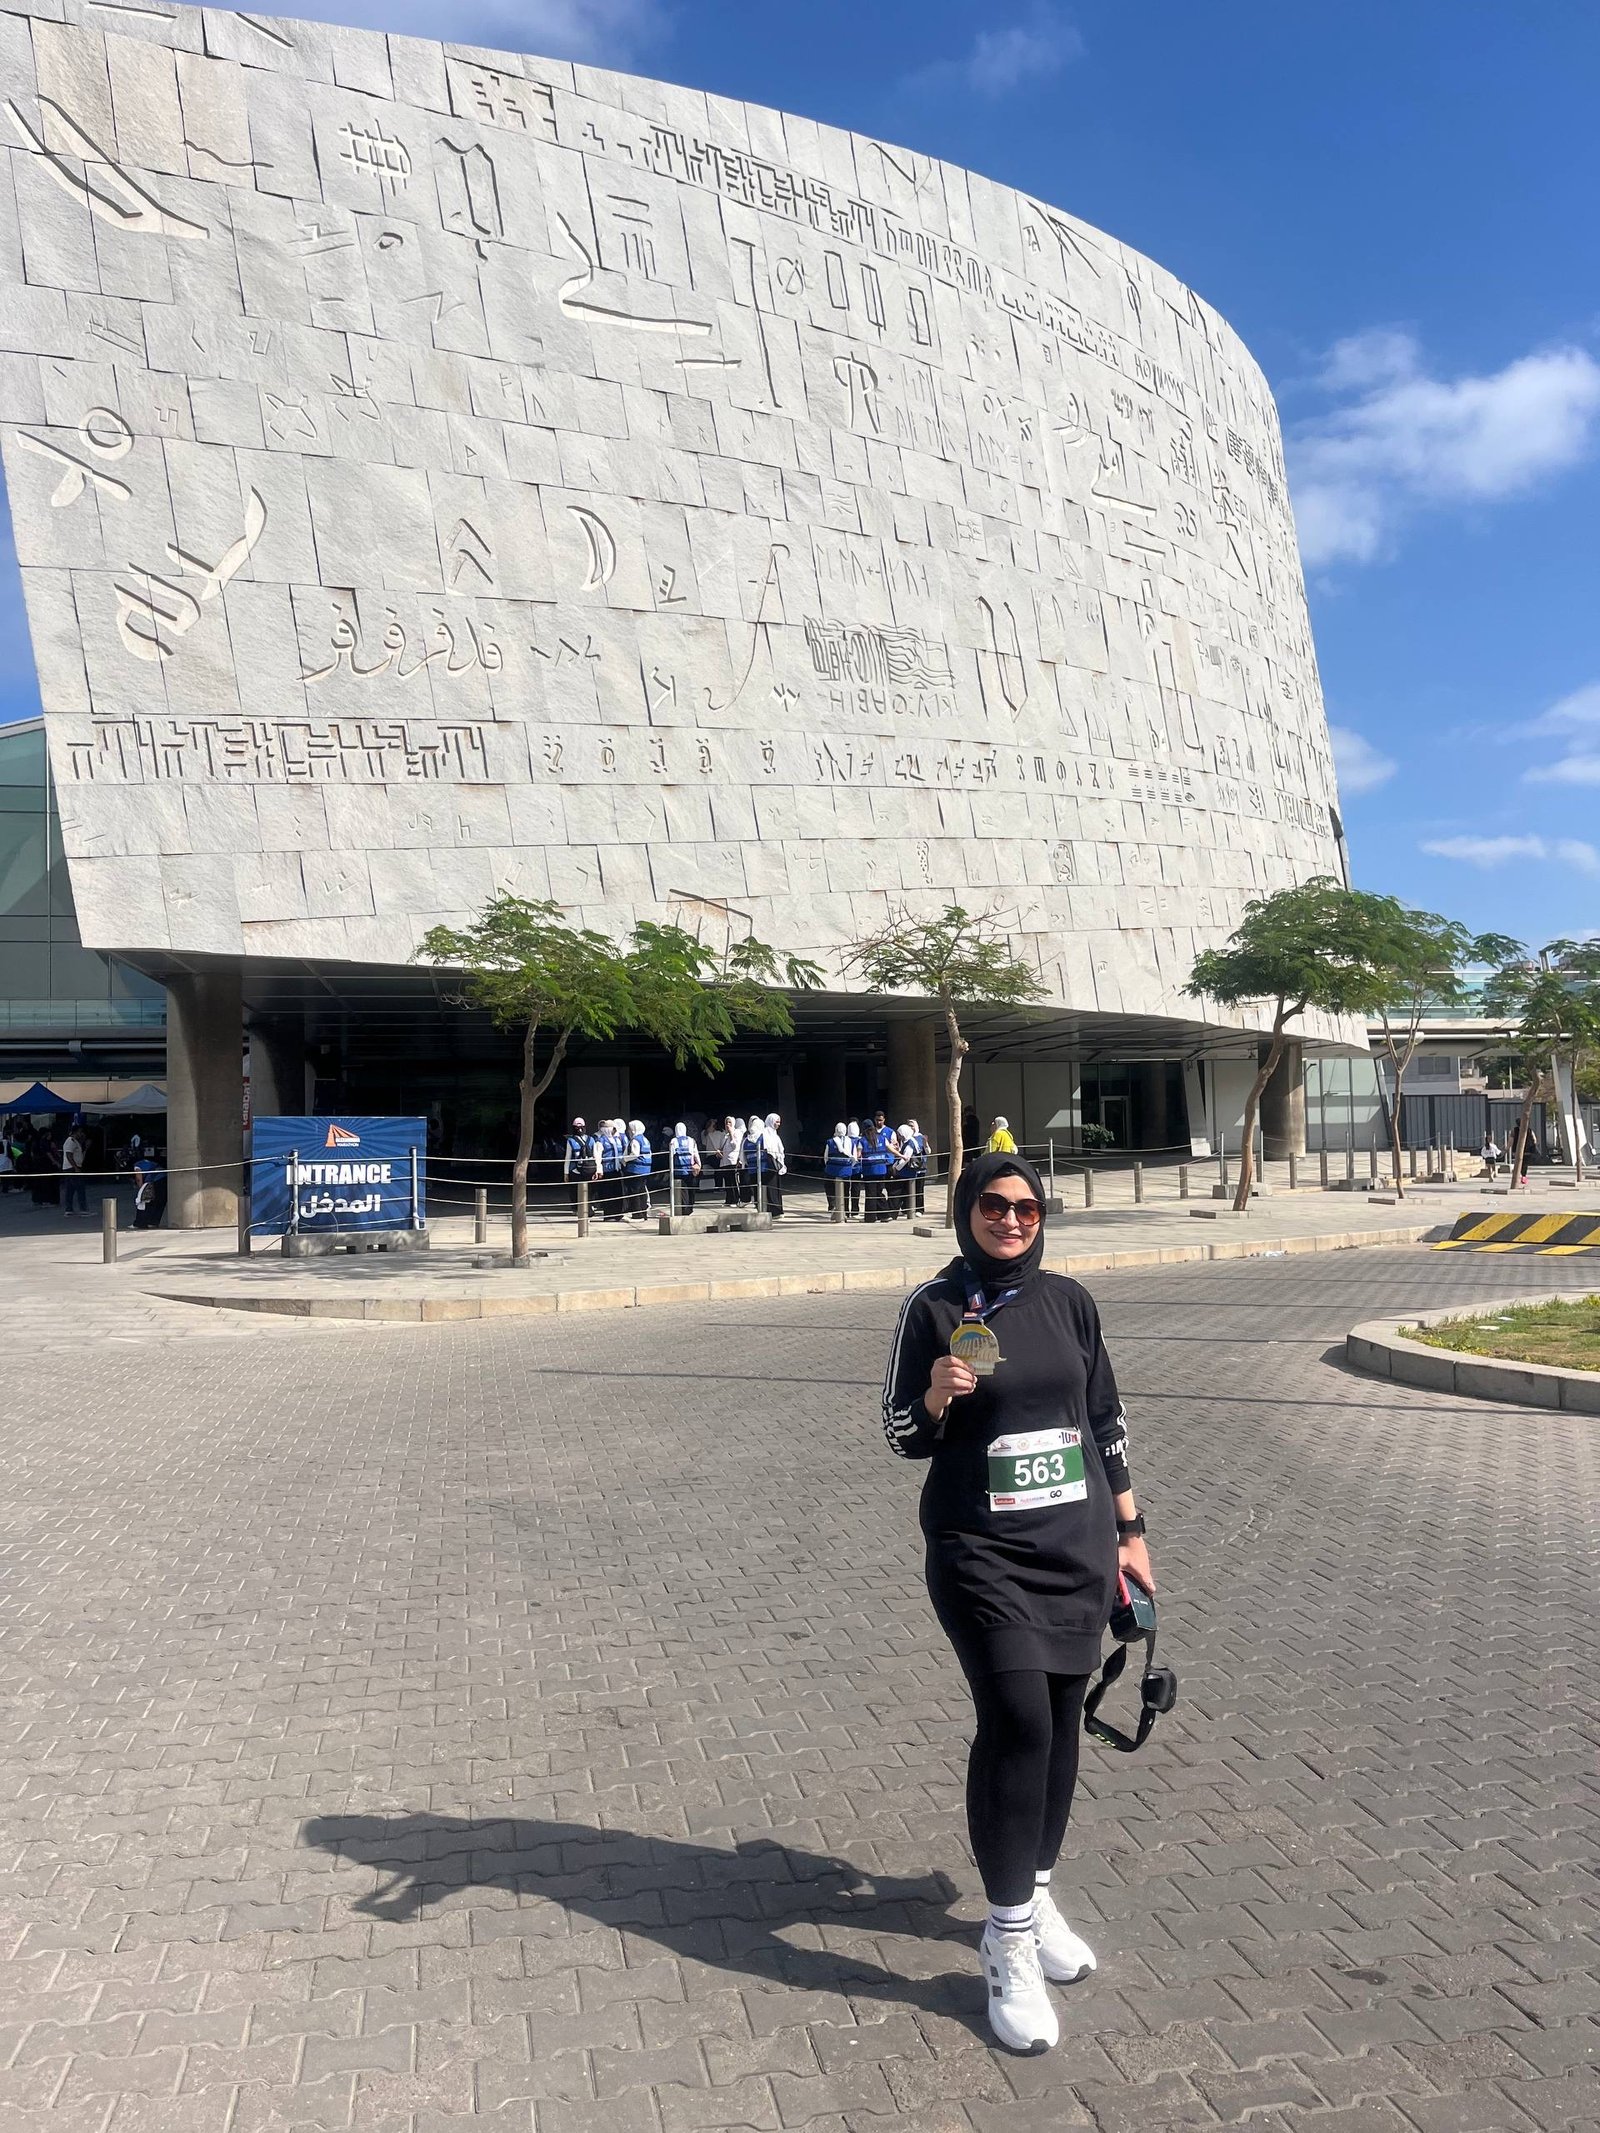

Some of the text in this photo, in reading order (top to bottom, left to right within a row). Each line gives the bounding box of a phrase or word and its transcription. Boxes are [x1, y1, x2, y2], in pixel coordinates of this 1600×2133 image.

[286, 1164, 391, 1185] ENTRANCE
[300, 1192, 380, 1218] المدخل
[1014, 1453, 1065, 1487] 563
[1050, 1489, 1062, 1498] GO
